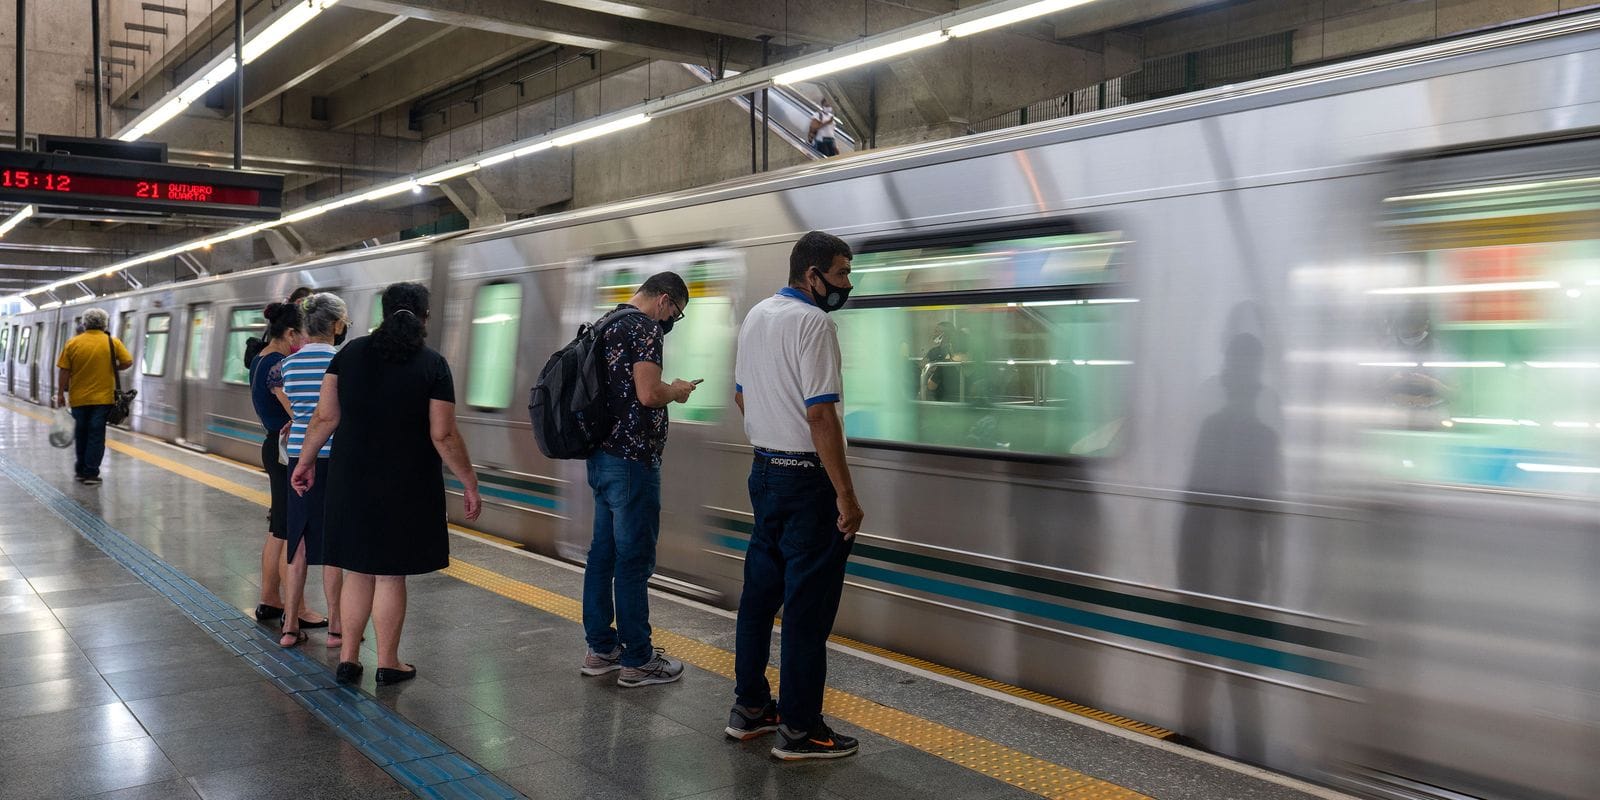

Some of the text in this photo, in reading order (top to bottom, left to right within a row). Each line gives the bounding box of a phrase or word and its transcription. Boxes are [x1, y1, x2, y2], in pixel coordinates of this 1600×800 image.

[3, 170, 160, 198] 15:12 21
[168, 183, 213, 195] OUTUBRO
[168, 191, 206, 202] QUARTA
